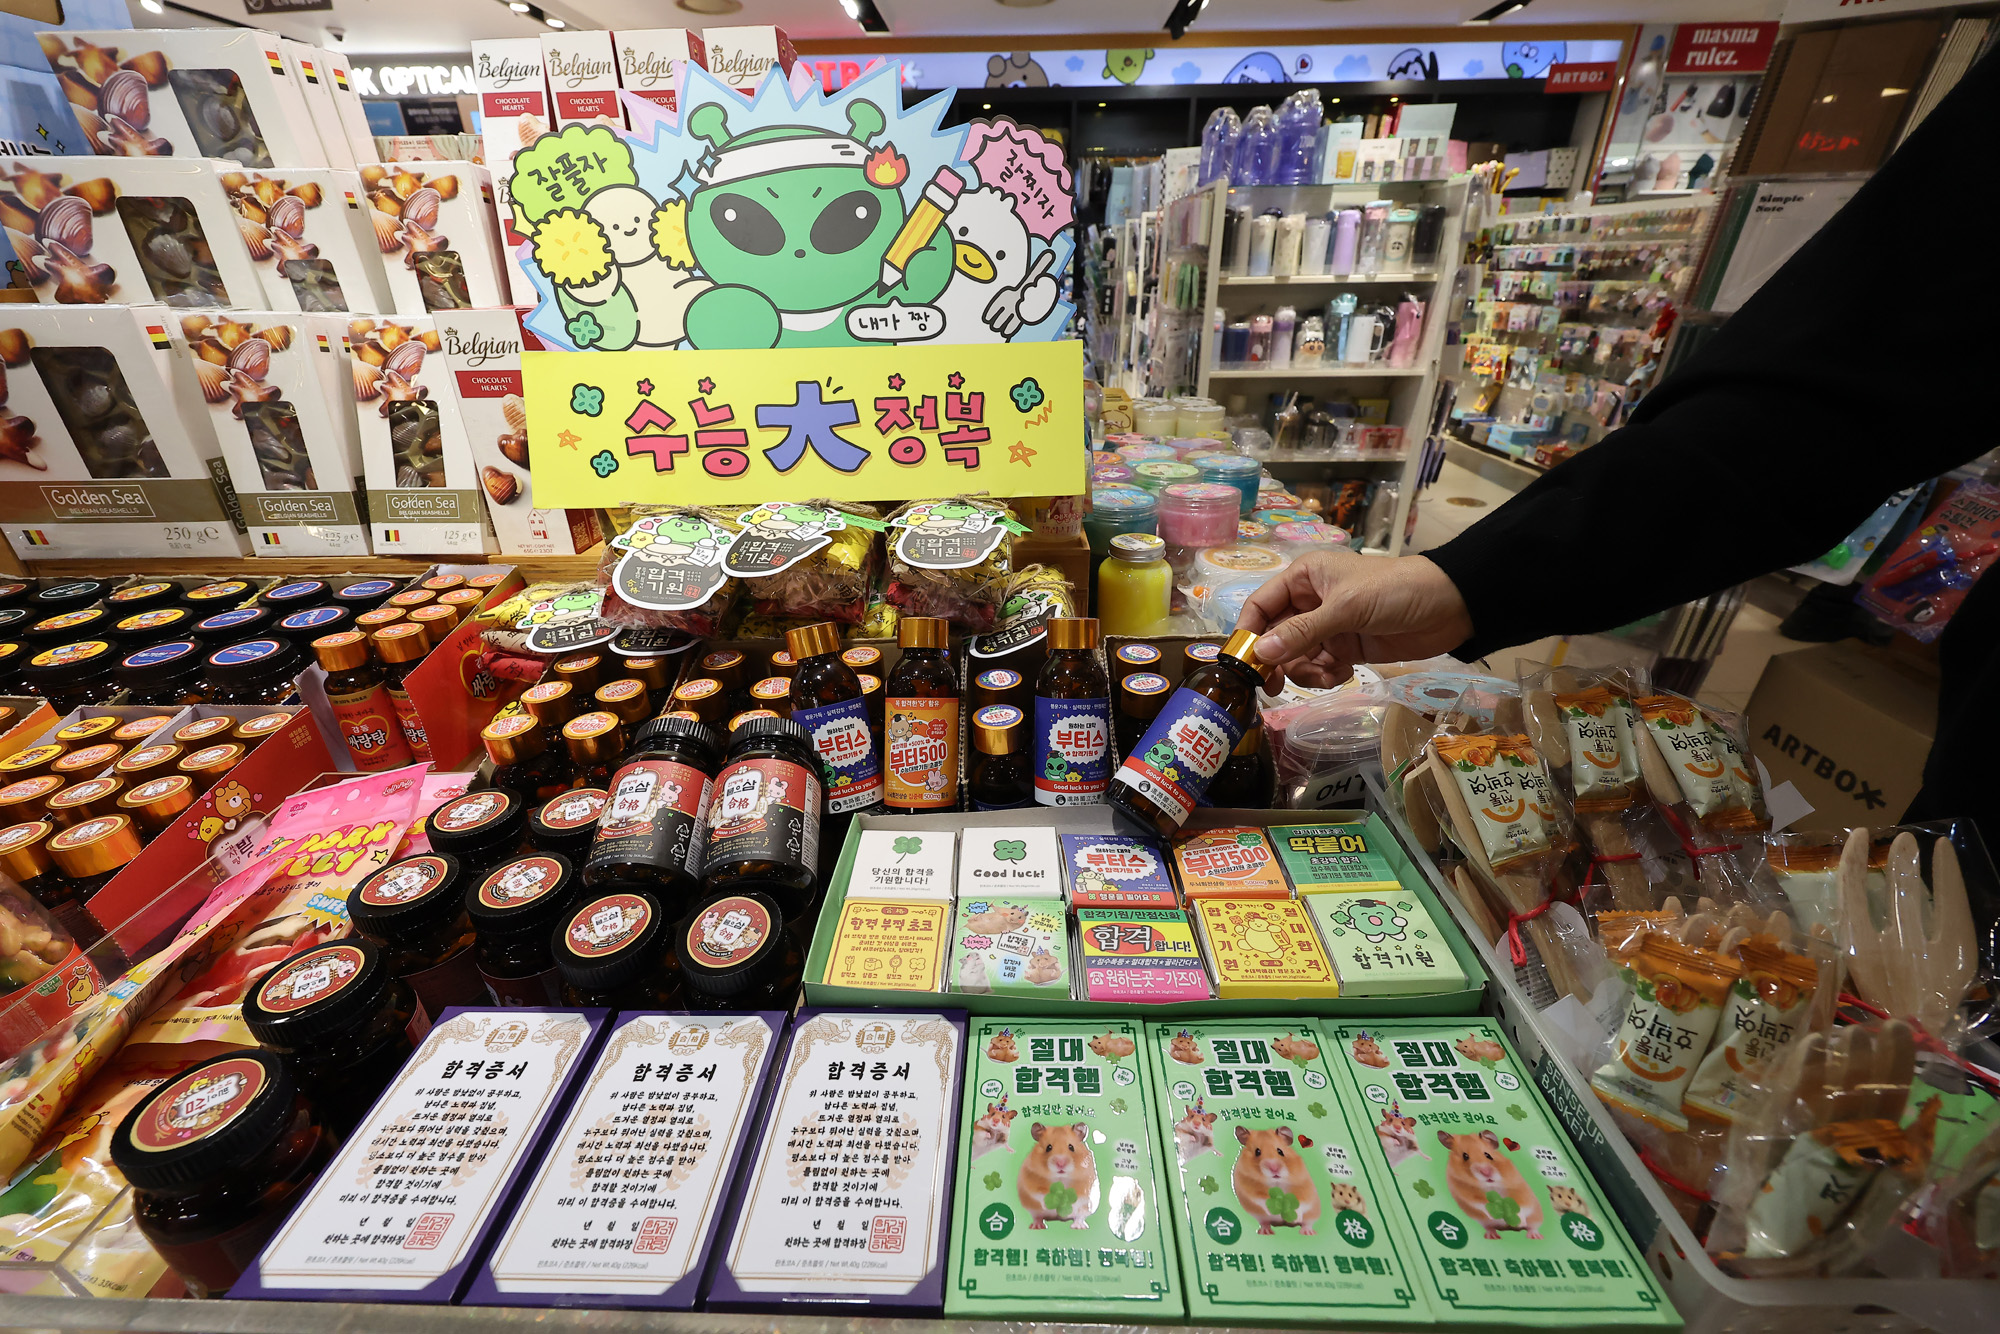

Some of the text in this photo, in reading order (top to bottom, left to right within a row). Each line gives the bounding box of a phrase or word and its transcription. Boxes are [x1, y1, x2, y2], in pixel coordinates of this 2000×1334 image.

[1692, 28, 1760, 44] masma
[478, 57, 541, 88] Belgian
[551, 56, 613, 88] Belgian
[495, 97, 531, 105] CHOCOLATE
[502, 104, 525, 112] HEARTS
[569, 97, 605, 105] CHOCOLATE
[577, 104, 600, 113] HEARTS
[527, 151, 609, 203] 잘풀자
[999, 148, 1056, 220] 잘찍자
[858, 311, 931, 332] 내가 짱
[448, 334, 521, 367] Belgian
[471, 376, 513, 385] CHOCOLATE
[481, 384, 508, 392] HEARTS
[51, 489, 145, 505] Golden Sea
[214, 460, 247, 530] Golden Sea
[391, 497, 457, 509] Golden Sea
[264, 500, 334, 513] Golden Sea
[163, 526, 191, 540] 250
[444, 530, 460, 540] 125
[749, 541, 783, 554] 합격
[928, 537, 962, 549] 합격
[745, 552, 775, 566] 기원
[927, 547, 962, 559] 기원
[648, 568, 686, 583] 합격
[646, 581, 685, 596] 기원
[1198, 723, 1215, 738] 원하는
[817, 730, 867, 756] 부터스
[1055, 730, 1105, 749] 부터스
[1176, 723, 1222, 770] 부터스
[891, 742, 947, 775] 부터500
[1184, 750, 1205, 768] 합격기원
[1145, 769, 1161, 782] Good
[1161, 779, 1174, 791] luck
[1173, 788, 1179, 796] to
[1469, 771, 1515, 795] 호박엿
[618, 798, 640, 812] 合格
[728, 797, 750, 810] 合格
[1489, 792, 1515, 811] 전통
[1288, 835, 1367, 854] 딱붙어
[1086, 853, 1148, 868] 부터스
[1184, 846, 1269, 877] 부터500
[1340, 856, 1361, 865] 합격
[872, 867, 935, 876] 당신의 합격을
[973, 869, 1045, 878] Good luck!
[875, 876, 928, 885] 기원합니다!
[1099, 893, 1151, 901] 행운을 빌어요
[851, 917, 934, 931] 합격 부적 초코
[1092, 925, 1152, 952] 합격
[1154, 940, 1192, 952] 합니다!
[1352, 950, 1436, 970] 합격기원
[1626, 1001, 1699, 1051] 호박엿
[1030, 1038, 1084, 1062] 절대
[1211, 1040, 1272, 1065] 절대
[1394, 1041, 1458, 1068] 절대
[1635, 1035, 1673, 1064] 전통
[441, 1060, 528, 1080] 합격증서
[633, 1063, 717, 1082] 합격증서
[829, 1061, 910, 1080] 합격증서
[1015, 1066, 1101, 1094] 합격햄
[1203, 1068, 1296, 1098] 합격햄
[1391, 1072, 1491, 1102] 합격햄
[809, 1090, 817, 1098] 위
[820, 1090, 844, 1098] 사람은
[847, 1090, 879, 1099] 밤낮없이
[824, 1102, 848, 1111] 남다른
[852, 1102, 877, 1111] 노력과
[1021, 1104, 1062, 1118] 합격길만
[1541, 1073, 1586, 1142] BASKET
[1545, 1060, 1605, 1147] SENSE-UP
[818, 1114, 899, 1124] 뜨거운 열정과 열의로
[1219, 1107, 1298, 1122] 합격길만 걸어요
[1418, 1111, 1499, 1126] 합격길만 걸어요
[791, 1127, 826, 1136] 누구보다
[830, 1127, 854, 1136] 뛰어난
[858, 1127, 882, 1137] 실력을
[781, 1196, 903, 1208] 미리 이 합격증을 수여합니다.
[985, 1211, 1009, 1231] 合
[1211, 1218, 1368, 1241] 合 格
[1436, 1220, 1597, 1244] 合 格
[785, 1236, 810, 1248] 원하는
[813, 1237, 831, 1248] 곳에
[1206, 1252, 1394, 1276] 합격햄! 축하햄! 행복햄!
[1438, 1256, 1633, 1279] 합격햄! 축하햄! 행복햄!
